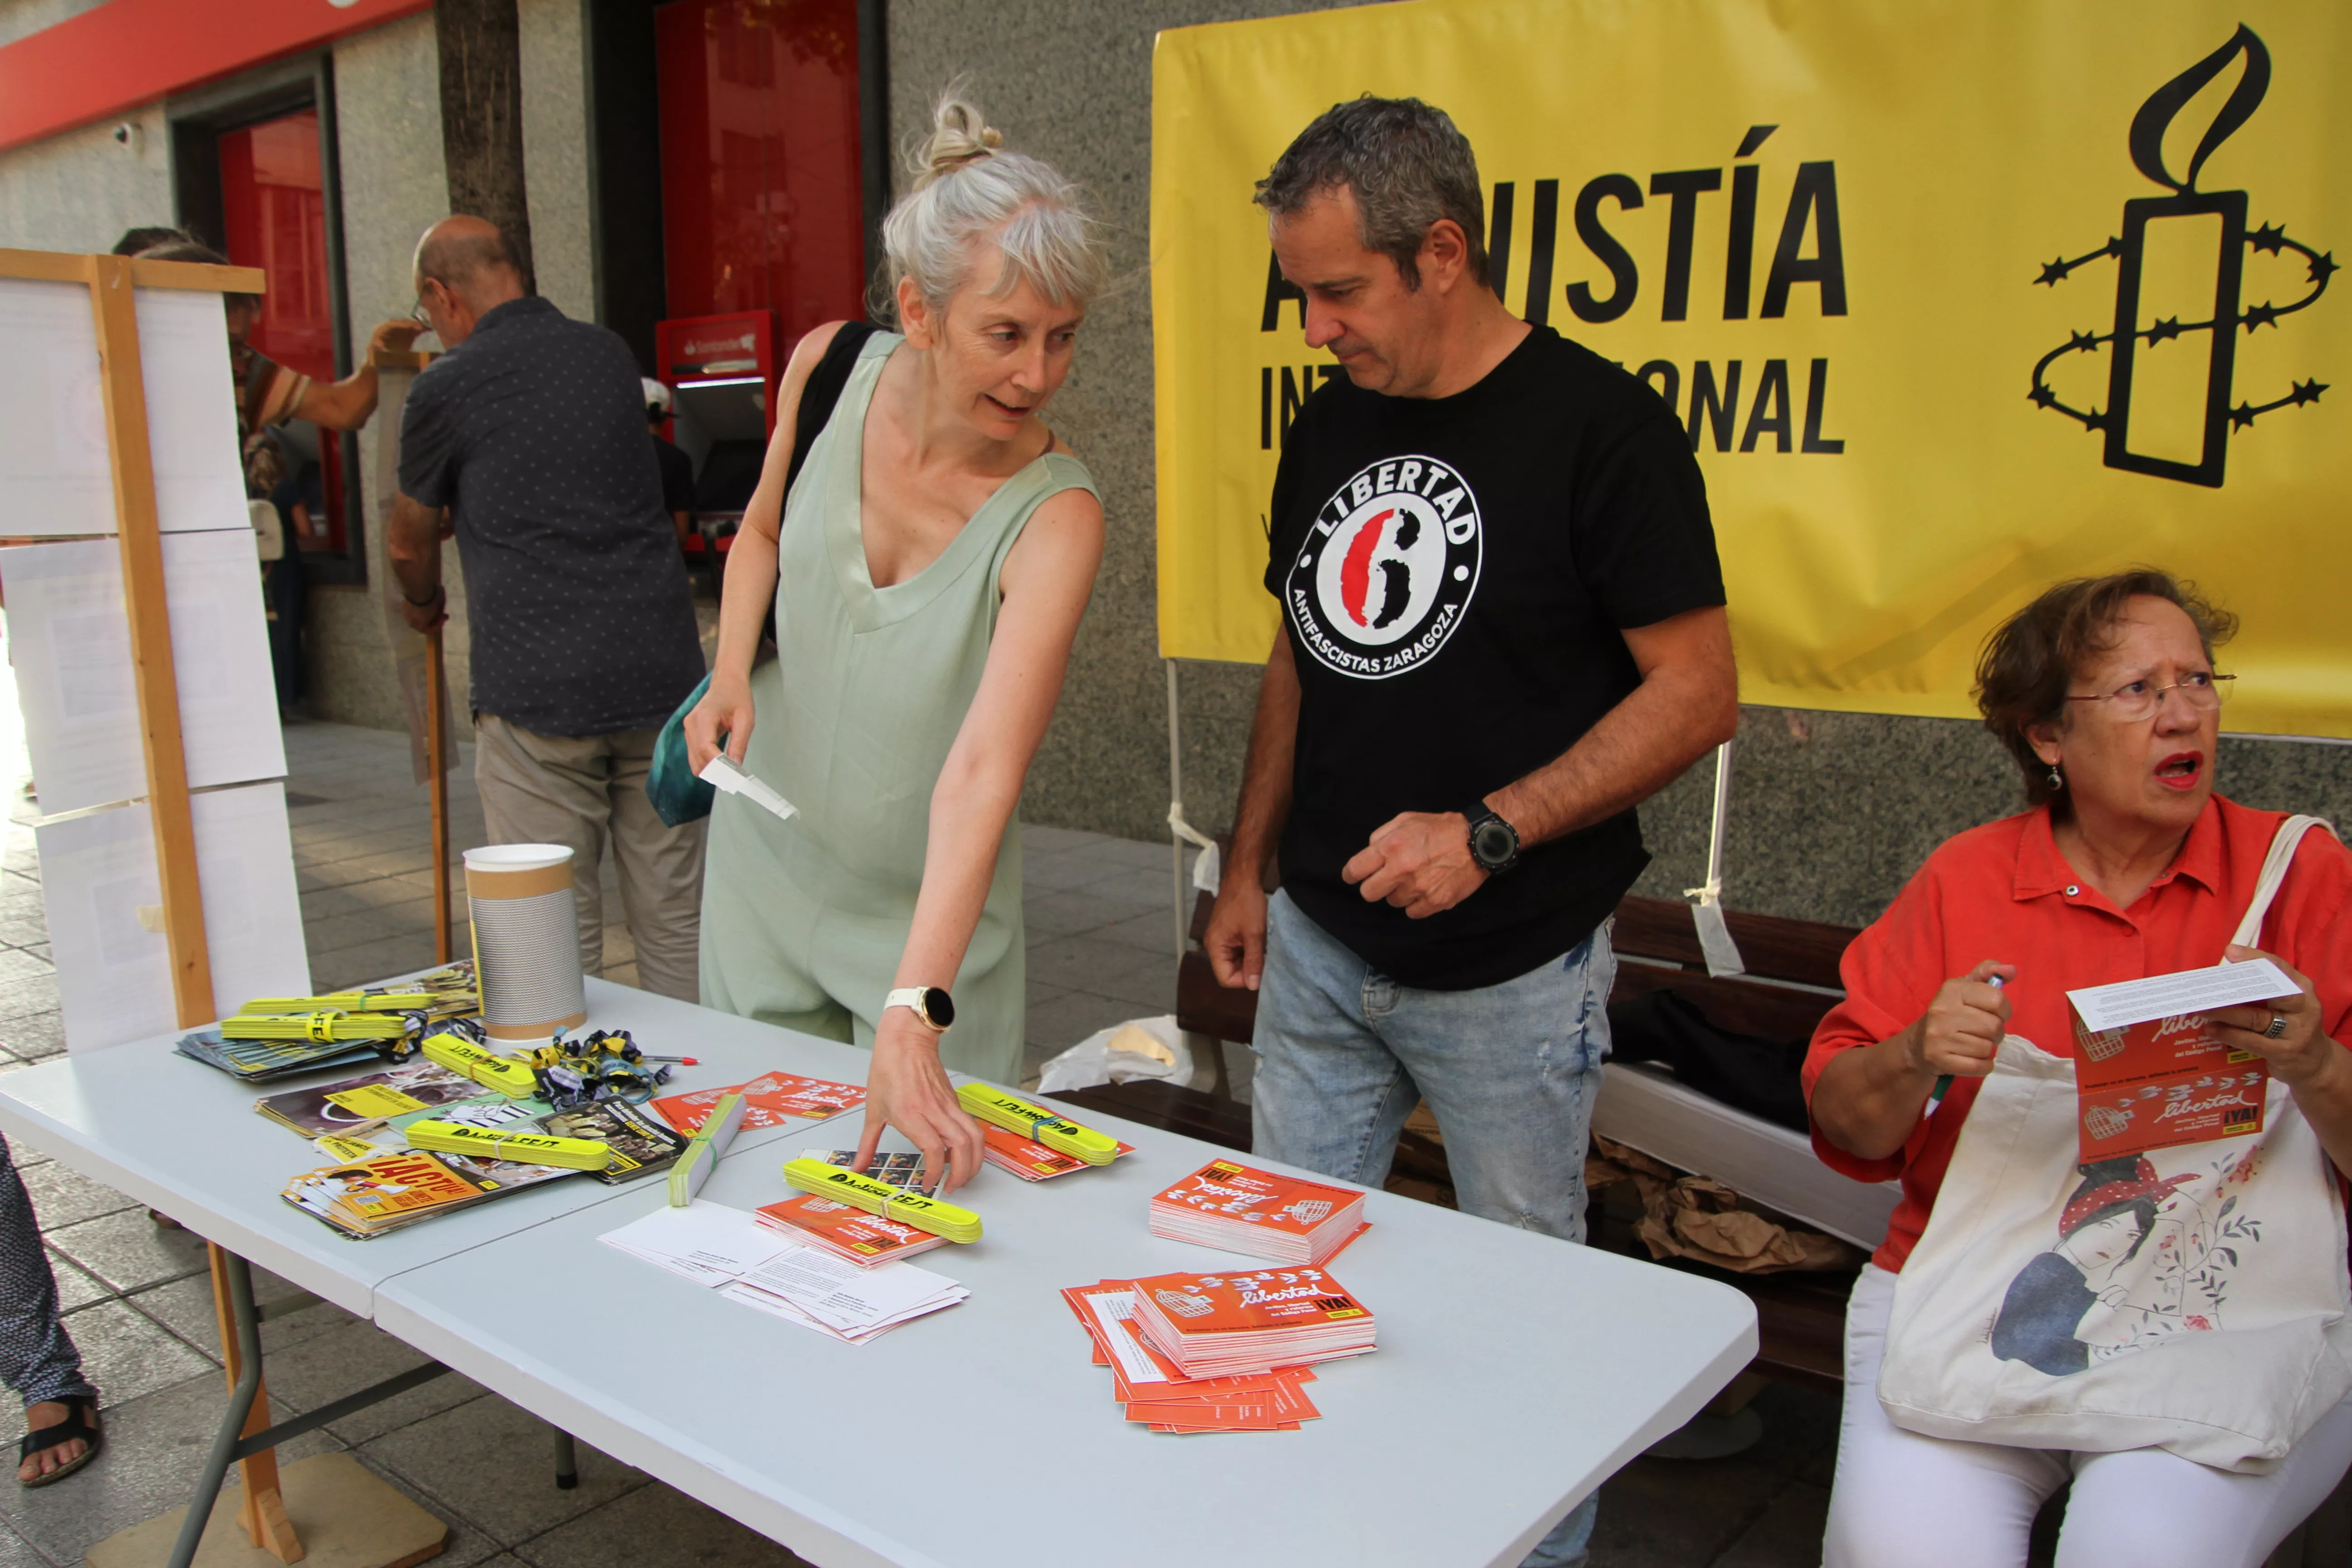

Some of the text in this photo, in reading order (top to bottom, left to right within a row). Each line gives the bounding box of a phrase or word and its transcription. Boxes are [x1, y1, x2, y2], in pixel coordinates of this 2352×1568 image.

[1316, 461, 1476, 545] LIBERTAD
[1294, 589, 1458, 673] ANTIFASCISTAS ZARAGOZA
[2153, 1090, 2258, 1123] libertad
[2224, 1106, 2259, 1124] ¡YA!
[368, 1156, 468, 1195] ¡ACTÚA!
[1198, 1168, 1235, 1183] ¡YA!
[1193, 1176, 1279, 1204] libertad
[843, 1215, 920, 1244] libertad
[1240, 1284, 1343, 1308] libertad
[1313, 1296, 1355, 1311] ¡YA!
